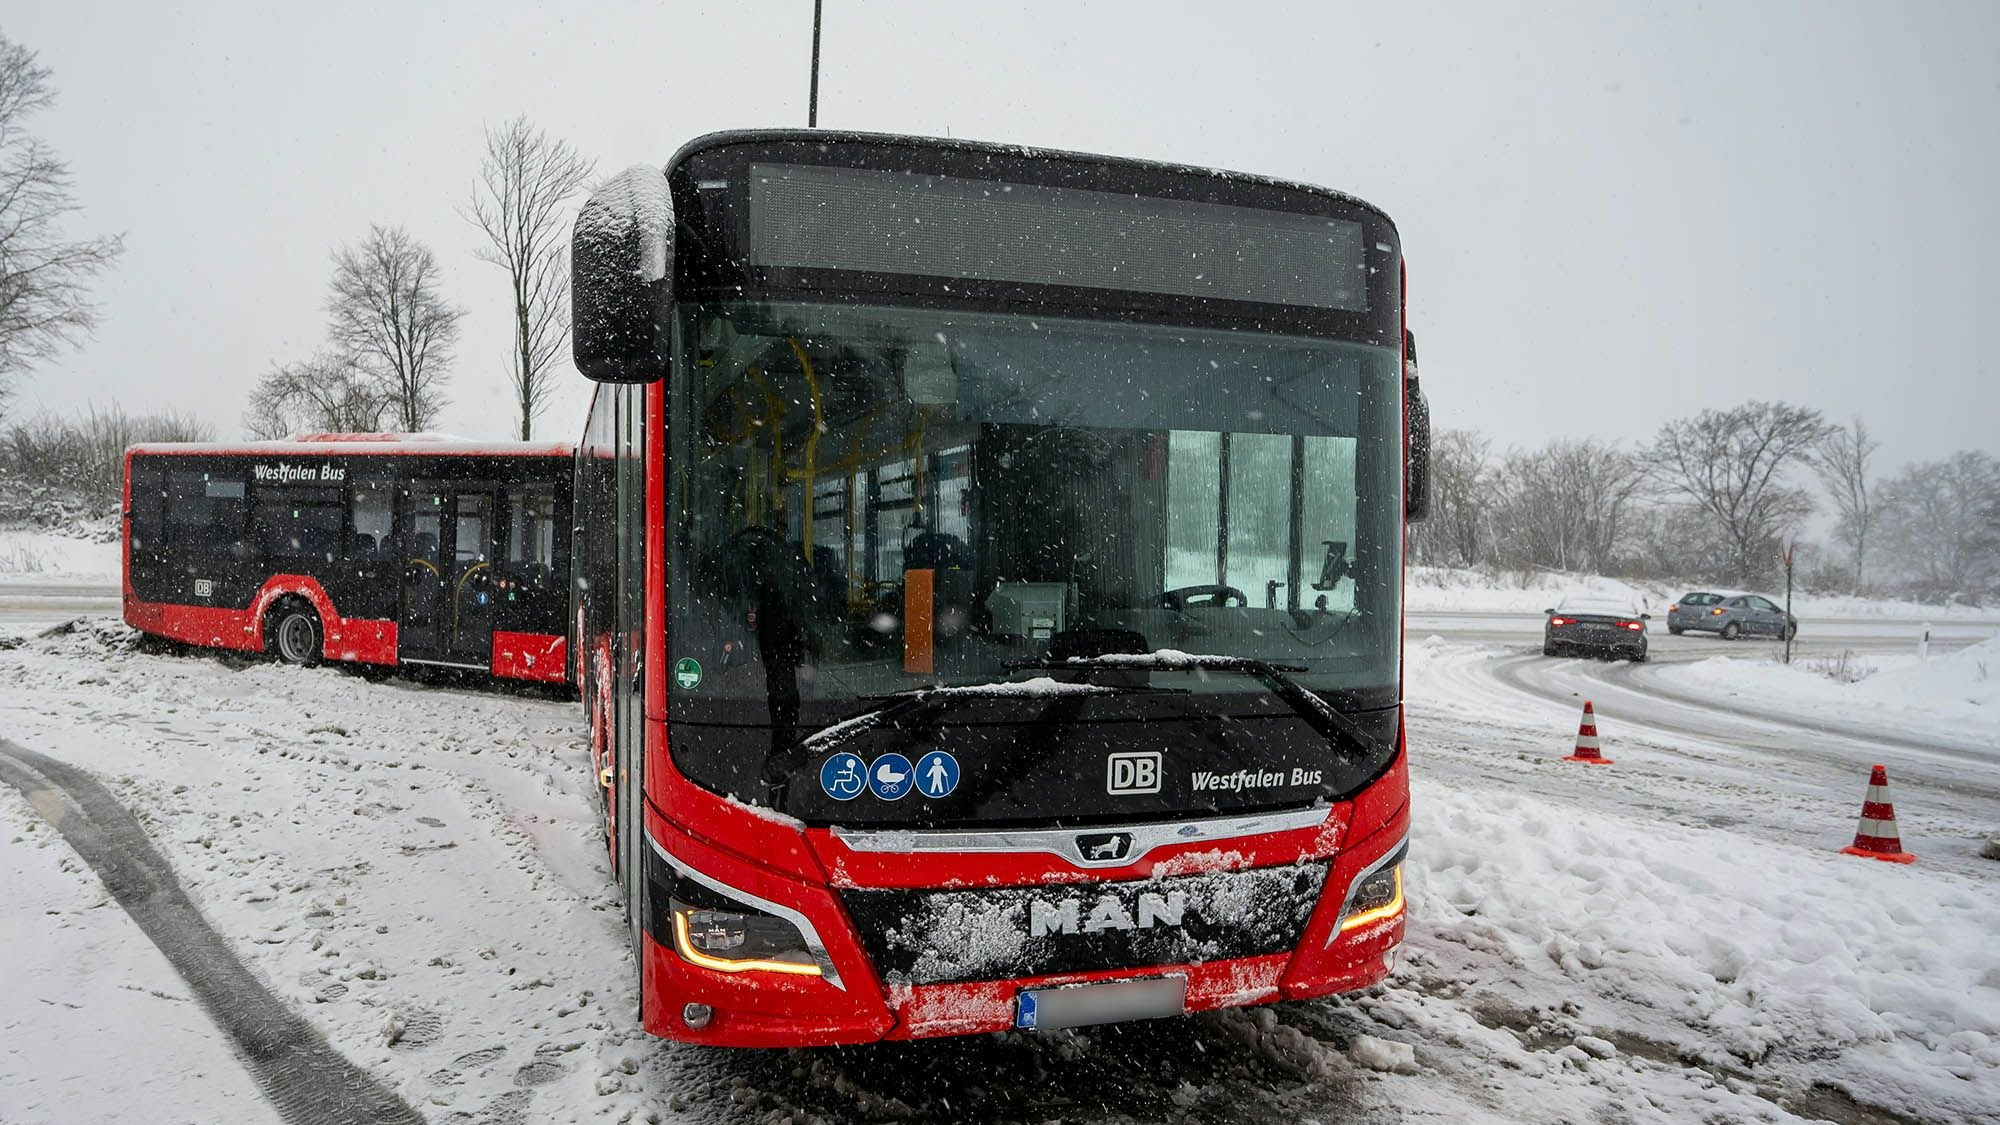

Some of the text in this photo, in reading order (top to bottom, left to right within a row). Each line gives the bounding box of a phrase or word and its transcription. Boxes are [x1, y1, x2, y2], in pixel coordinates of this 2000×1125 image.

[254, 464, 345, 483] Westfalen Bus
[197, 582, 210, 594] DB
[1113, 757, 1157, 789] DB
[1191, 767, 1323, 793] Westfalen Bus
[1030, 890, 1187, 937] MAN
